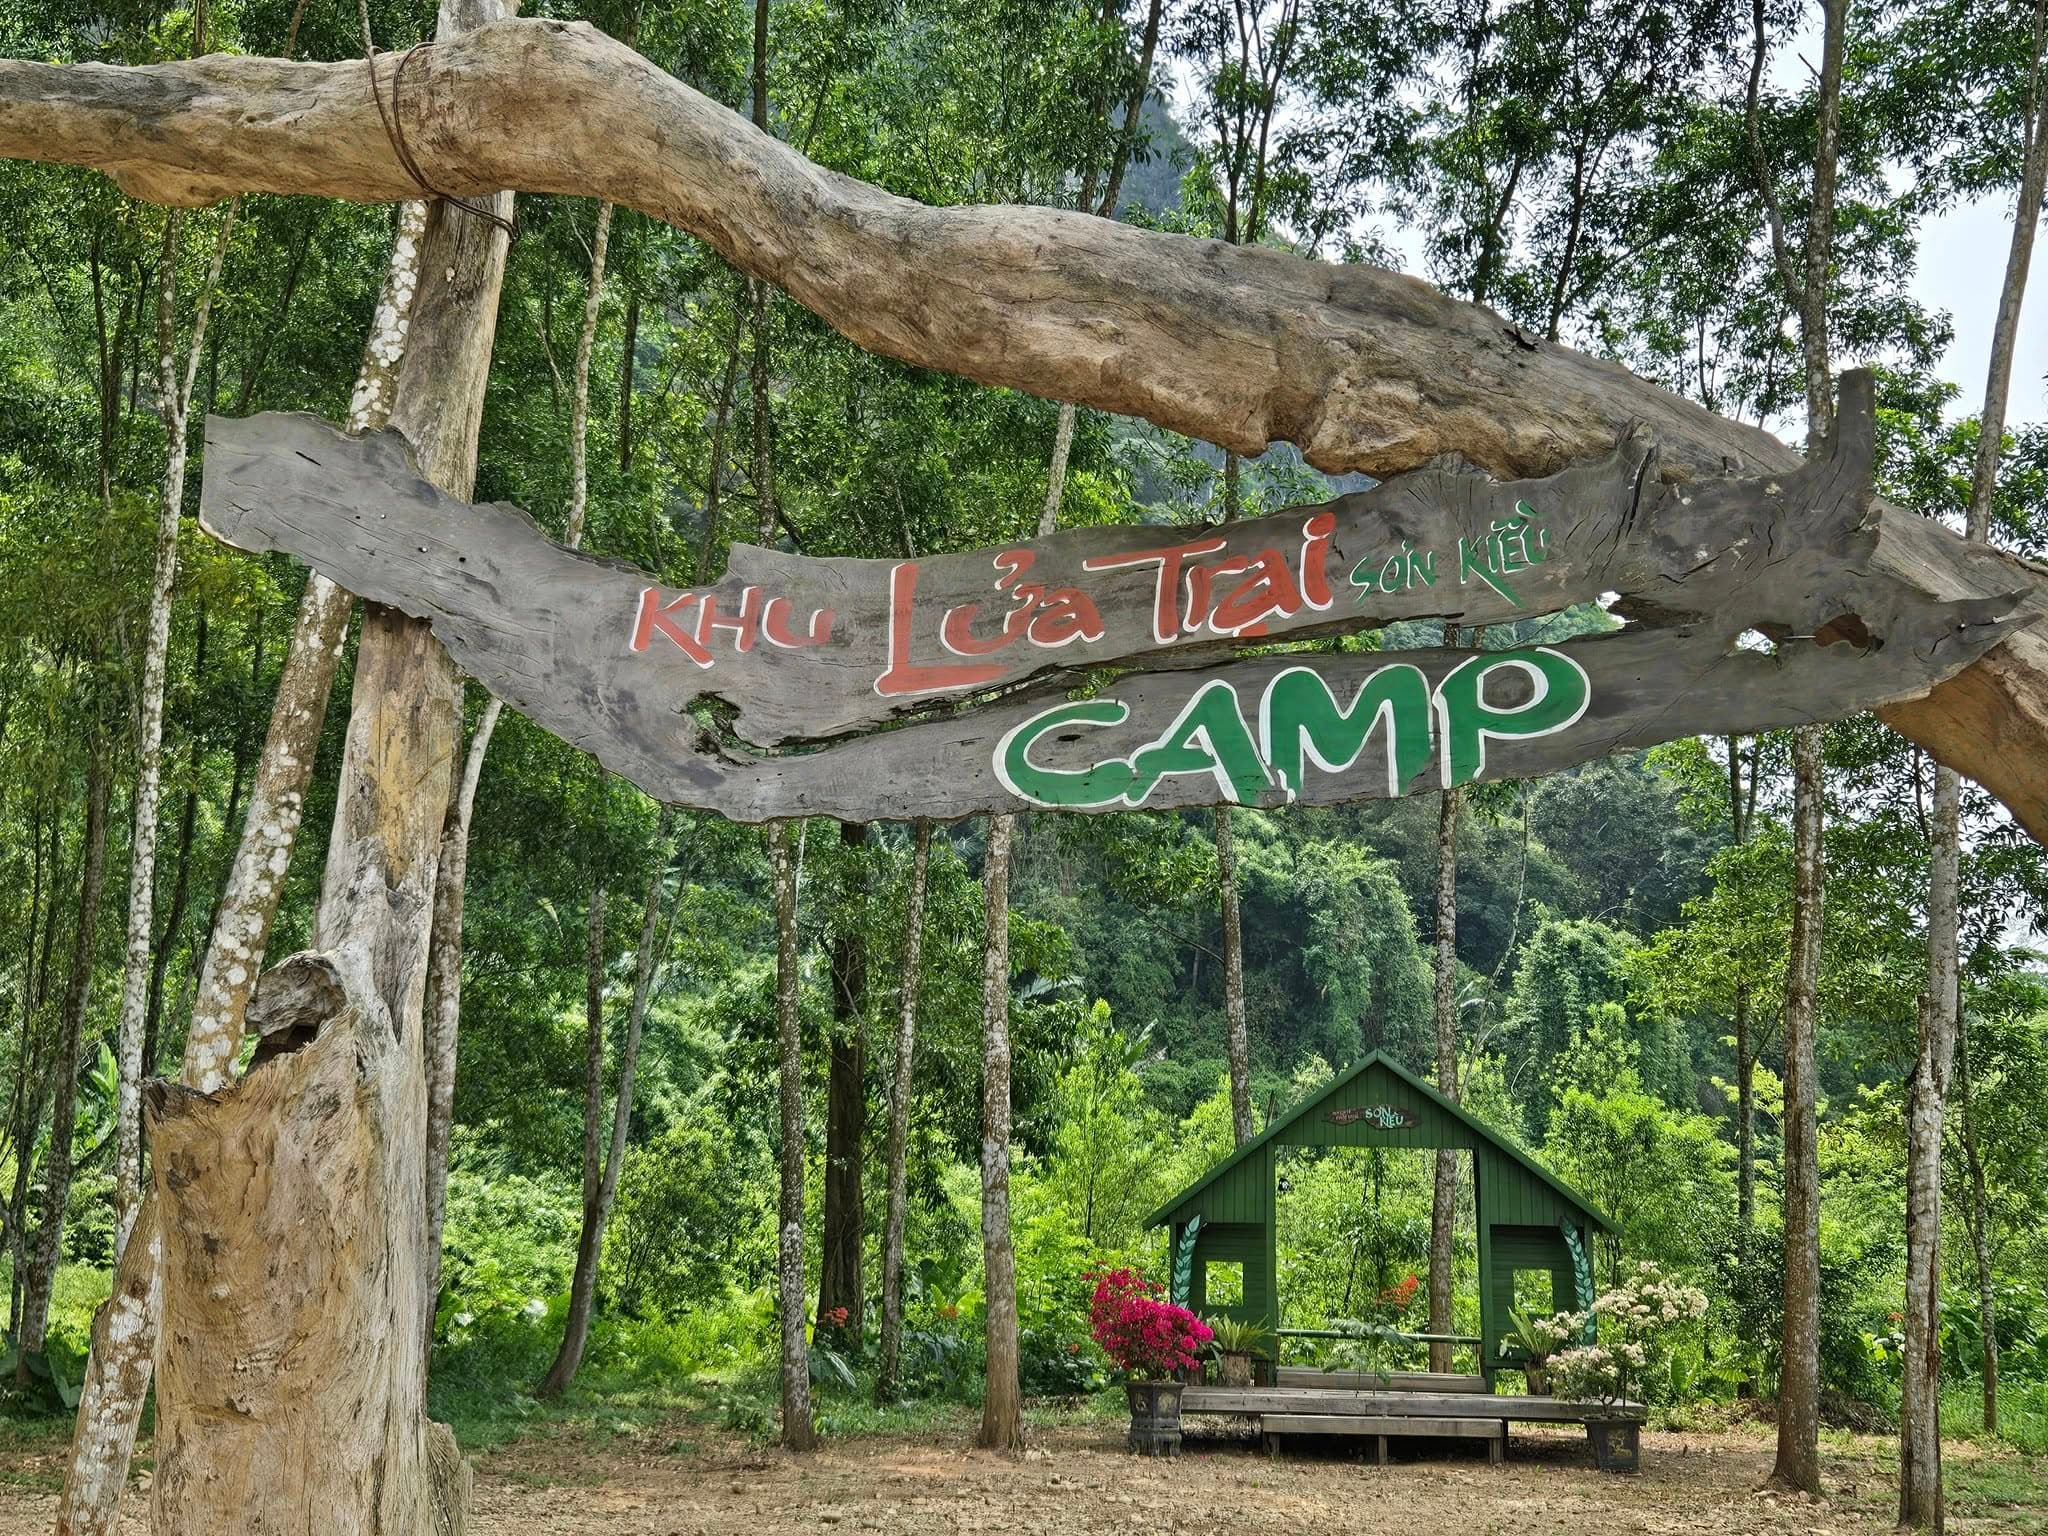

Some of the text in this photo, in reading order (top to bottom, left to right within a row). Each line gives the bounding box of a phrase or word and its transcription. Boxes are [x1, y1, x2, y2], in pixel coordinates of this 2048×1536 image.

[629, 498, 1551, 697] KHU Lửa Trại SƠN KIỀU
[992, 646, 1592, 808] CAMP
